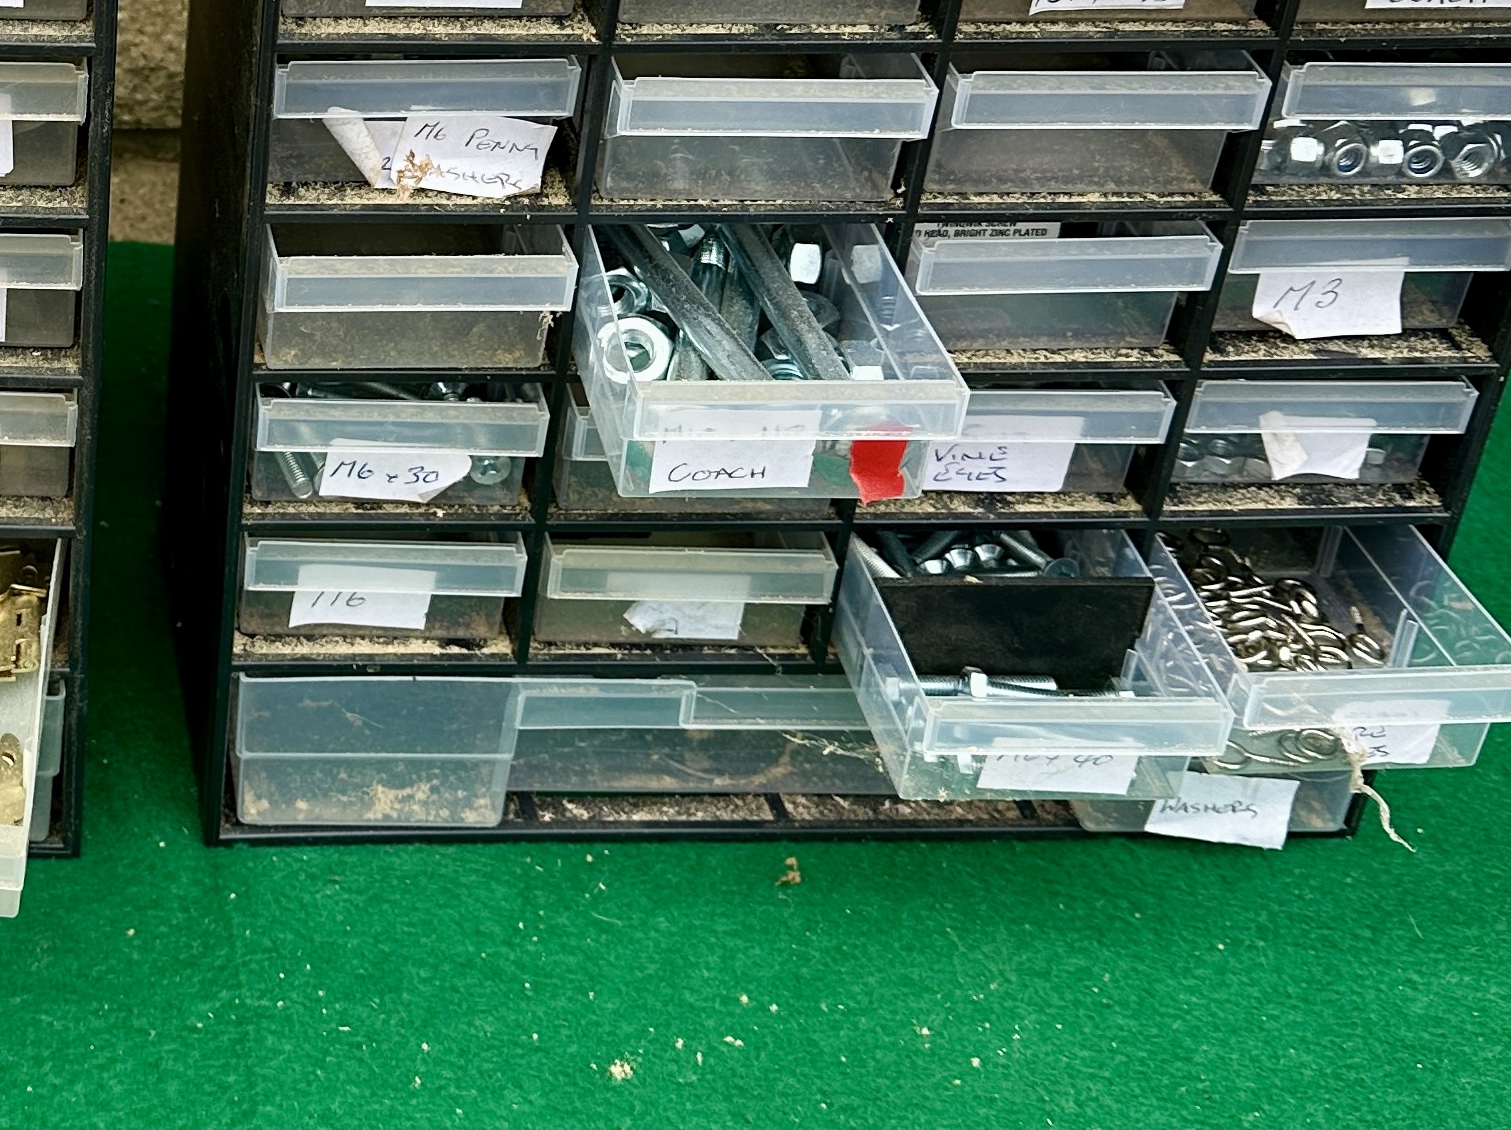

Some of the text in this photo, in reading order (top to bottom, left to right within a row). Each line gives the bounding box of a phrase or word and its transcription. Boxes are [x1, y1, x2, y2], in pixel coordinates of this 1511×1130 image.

[424, 161, 524, 190] ASHERS
[1012, 228, 1049, 237] PLATED
[330, 460, 373, 479] M6
[404, 466, 439, 484] 30
[667, 462, 767, 483] COACH
[1158, 797, 1259, 818] WASHERS
